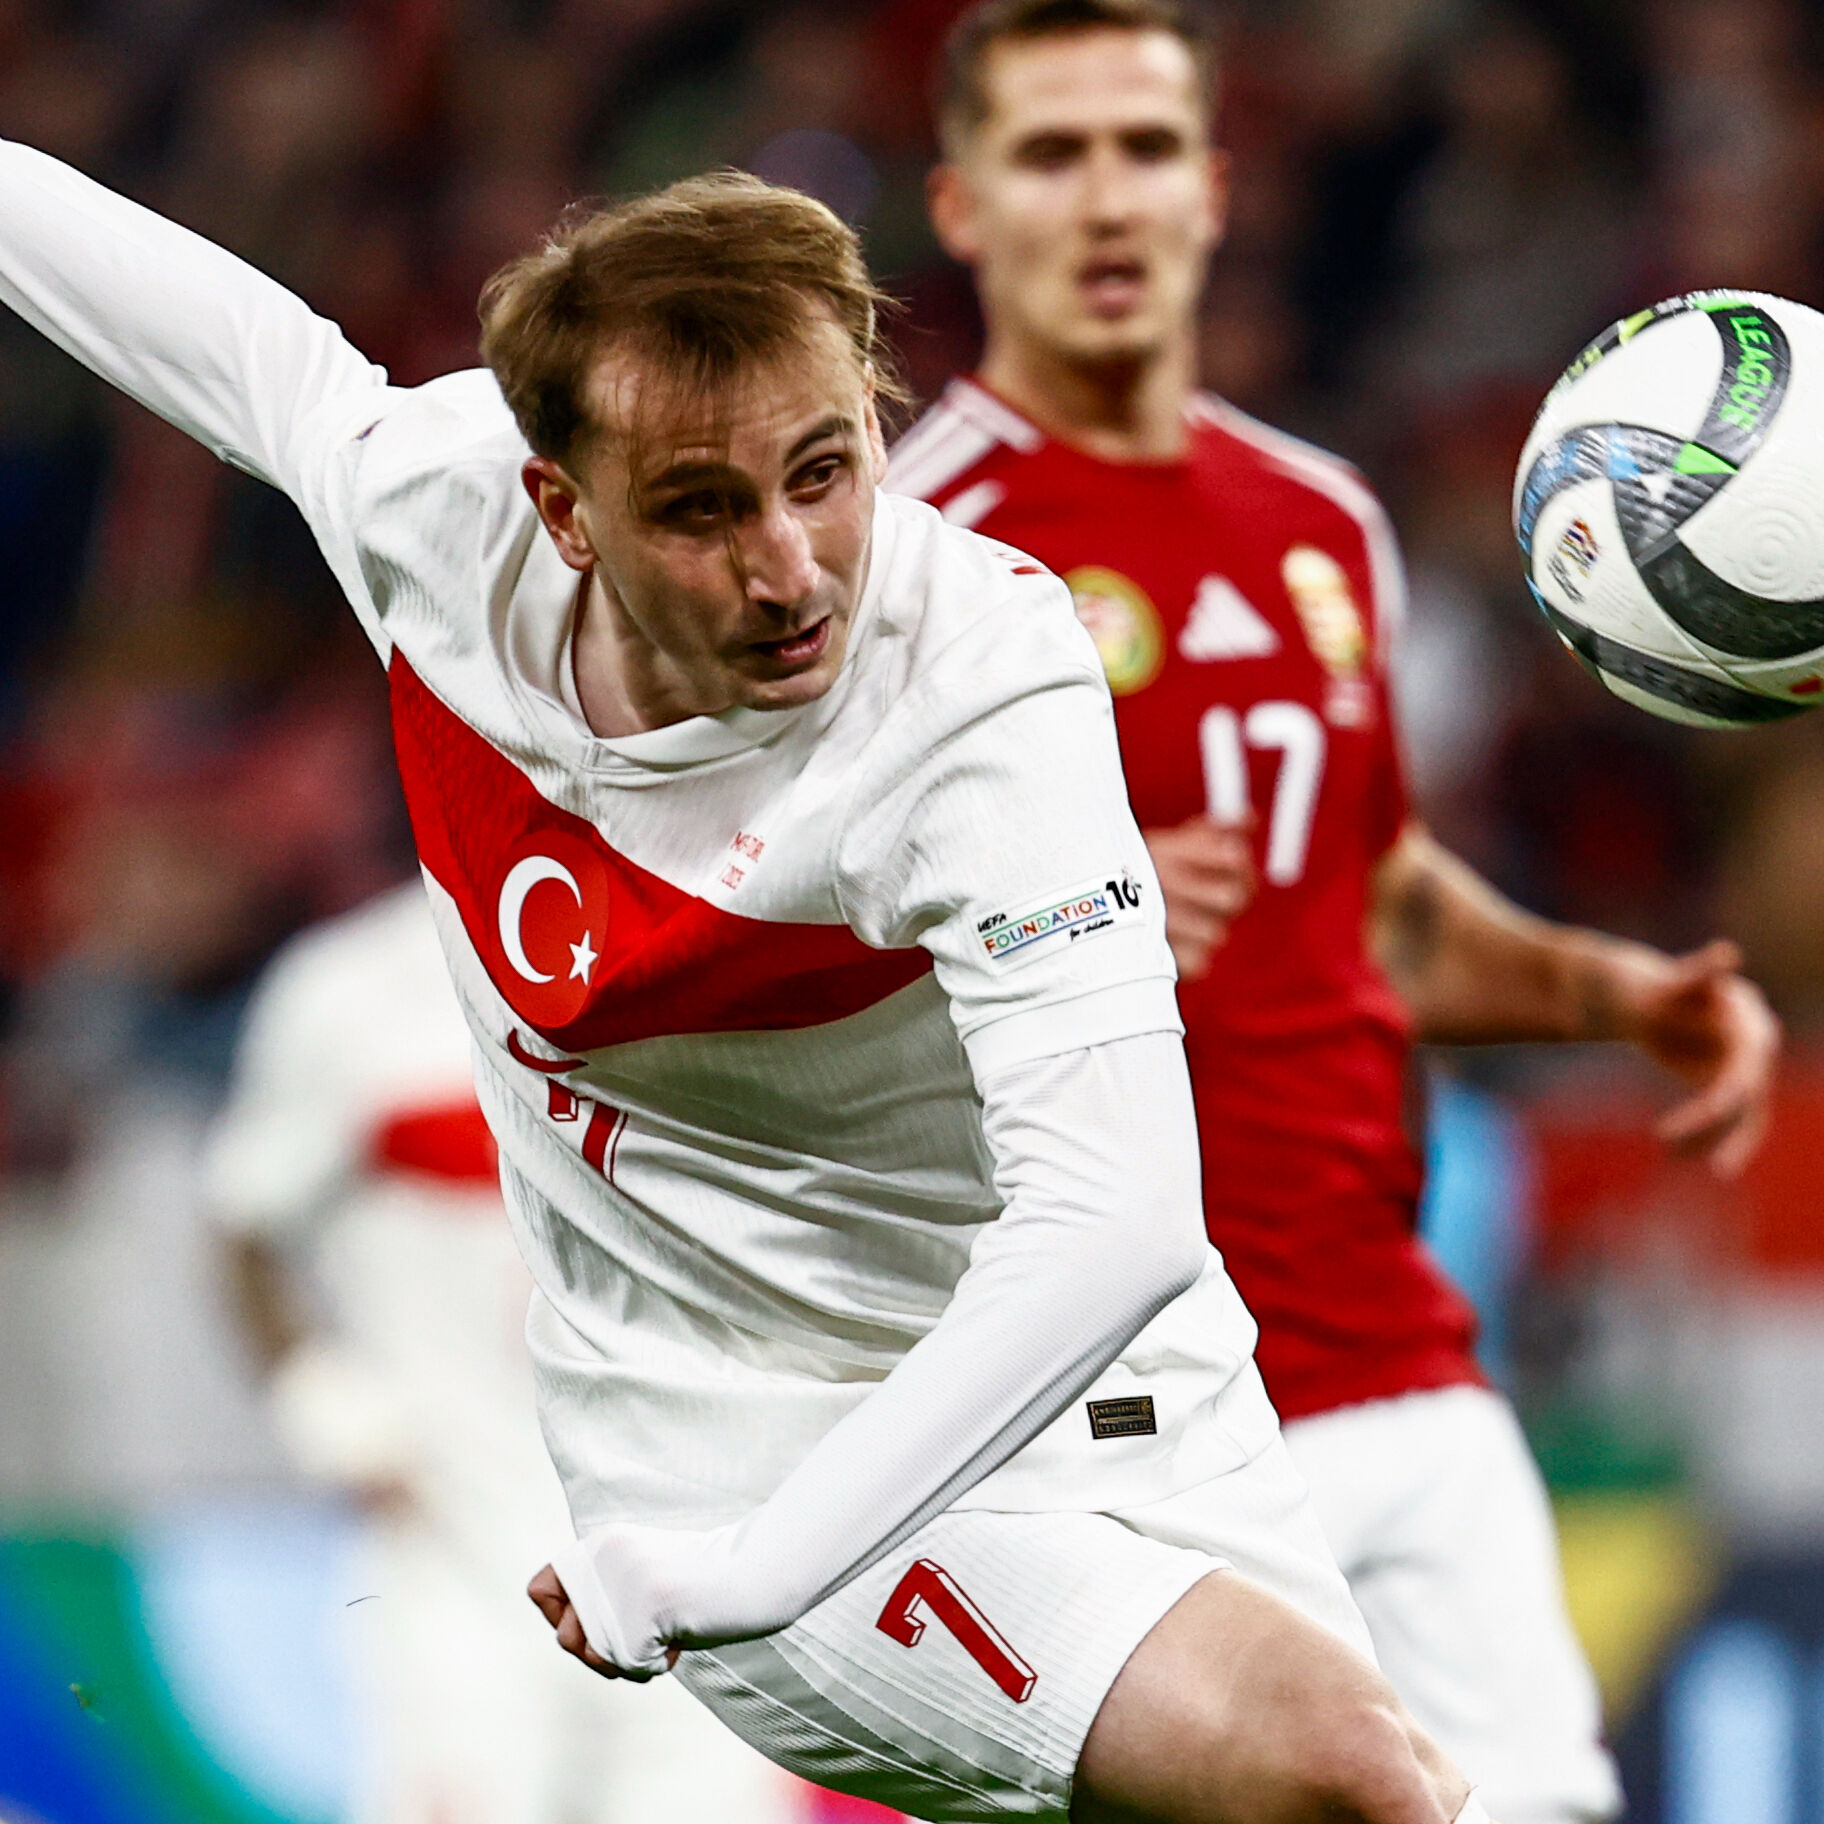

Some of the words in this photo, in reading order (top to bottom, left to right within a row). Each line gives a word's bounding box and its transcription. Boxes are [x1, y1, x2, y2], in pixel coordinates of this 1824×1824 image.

[1718, 315, 1776, 434] LEAGUE
[1198, 701, 1329, 887] 17
[977, 912, 1007, 933] UEFA
[984, 895, 1108, 955] FOUNDATION
[875, 1558, 1038, 1704] 7
